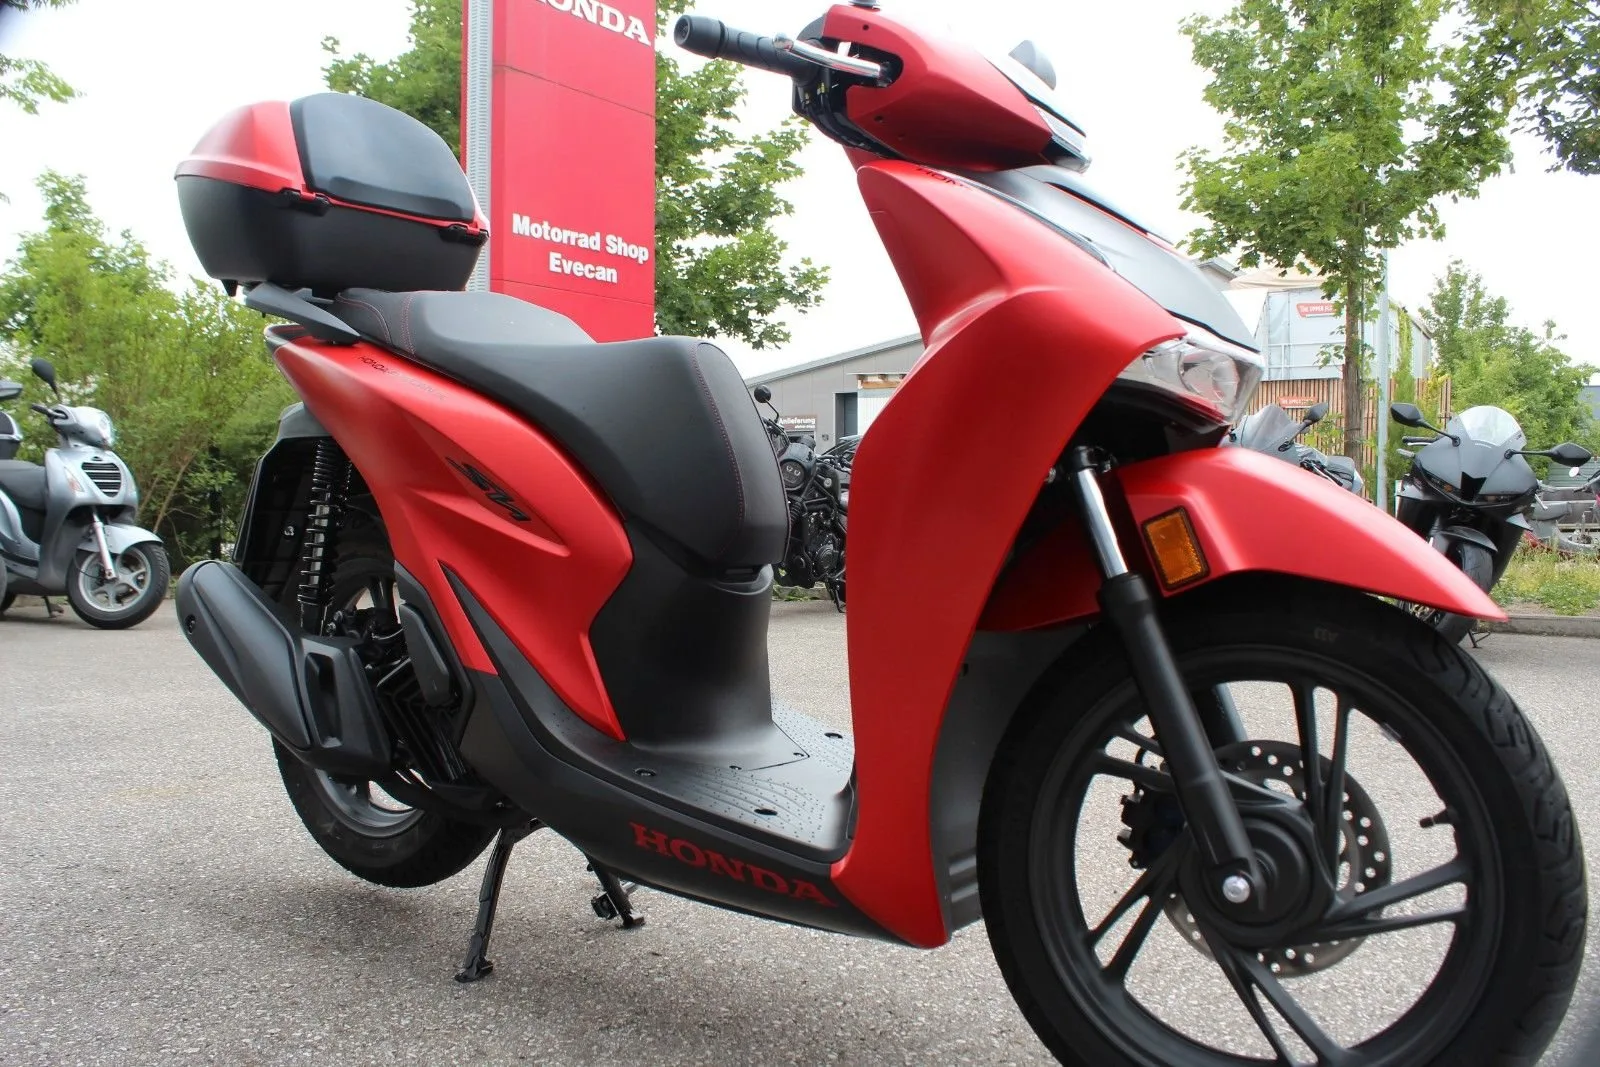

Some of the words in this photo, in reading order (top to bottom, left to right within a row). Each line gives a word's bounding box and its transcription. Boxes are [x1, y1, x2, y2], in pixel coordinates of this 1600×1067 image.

[535, 0, 651, 46] ONDA
[512, 213, 601, 251] Motorrad
[605, 234, 649, 264] Shop
[549, 251, 618, 283] Evecan
[779, 417, 816, 425] Anlieferung
[629, 821, 839, 908] HONDA
